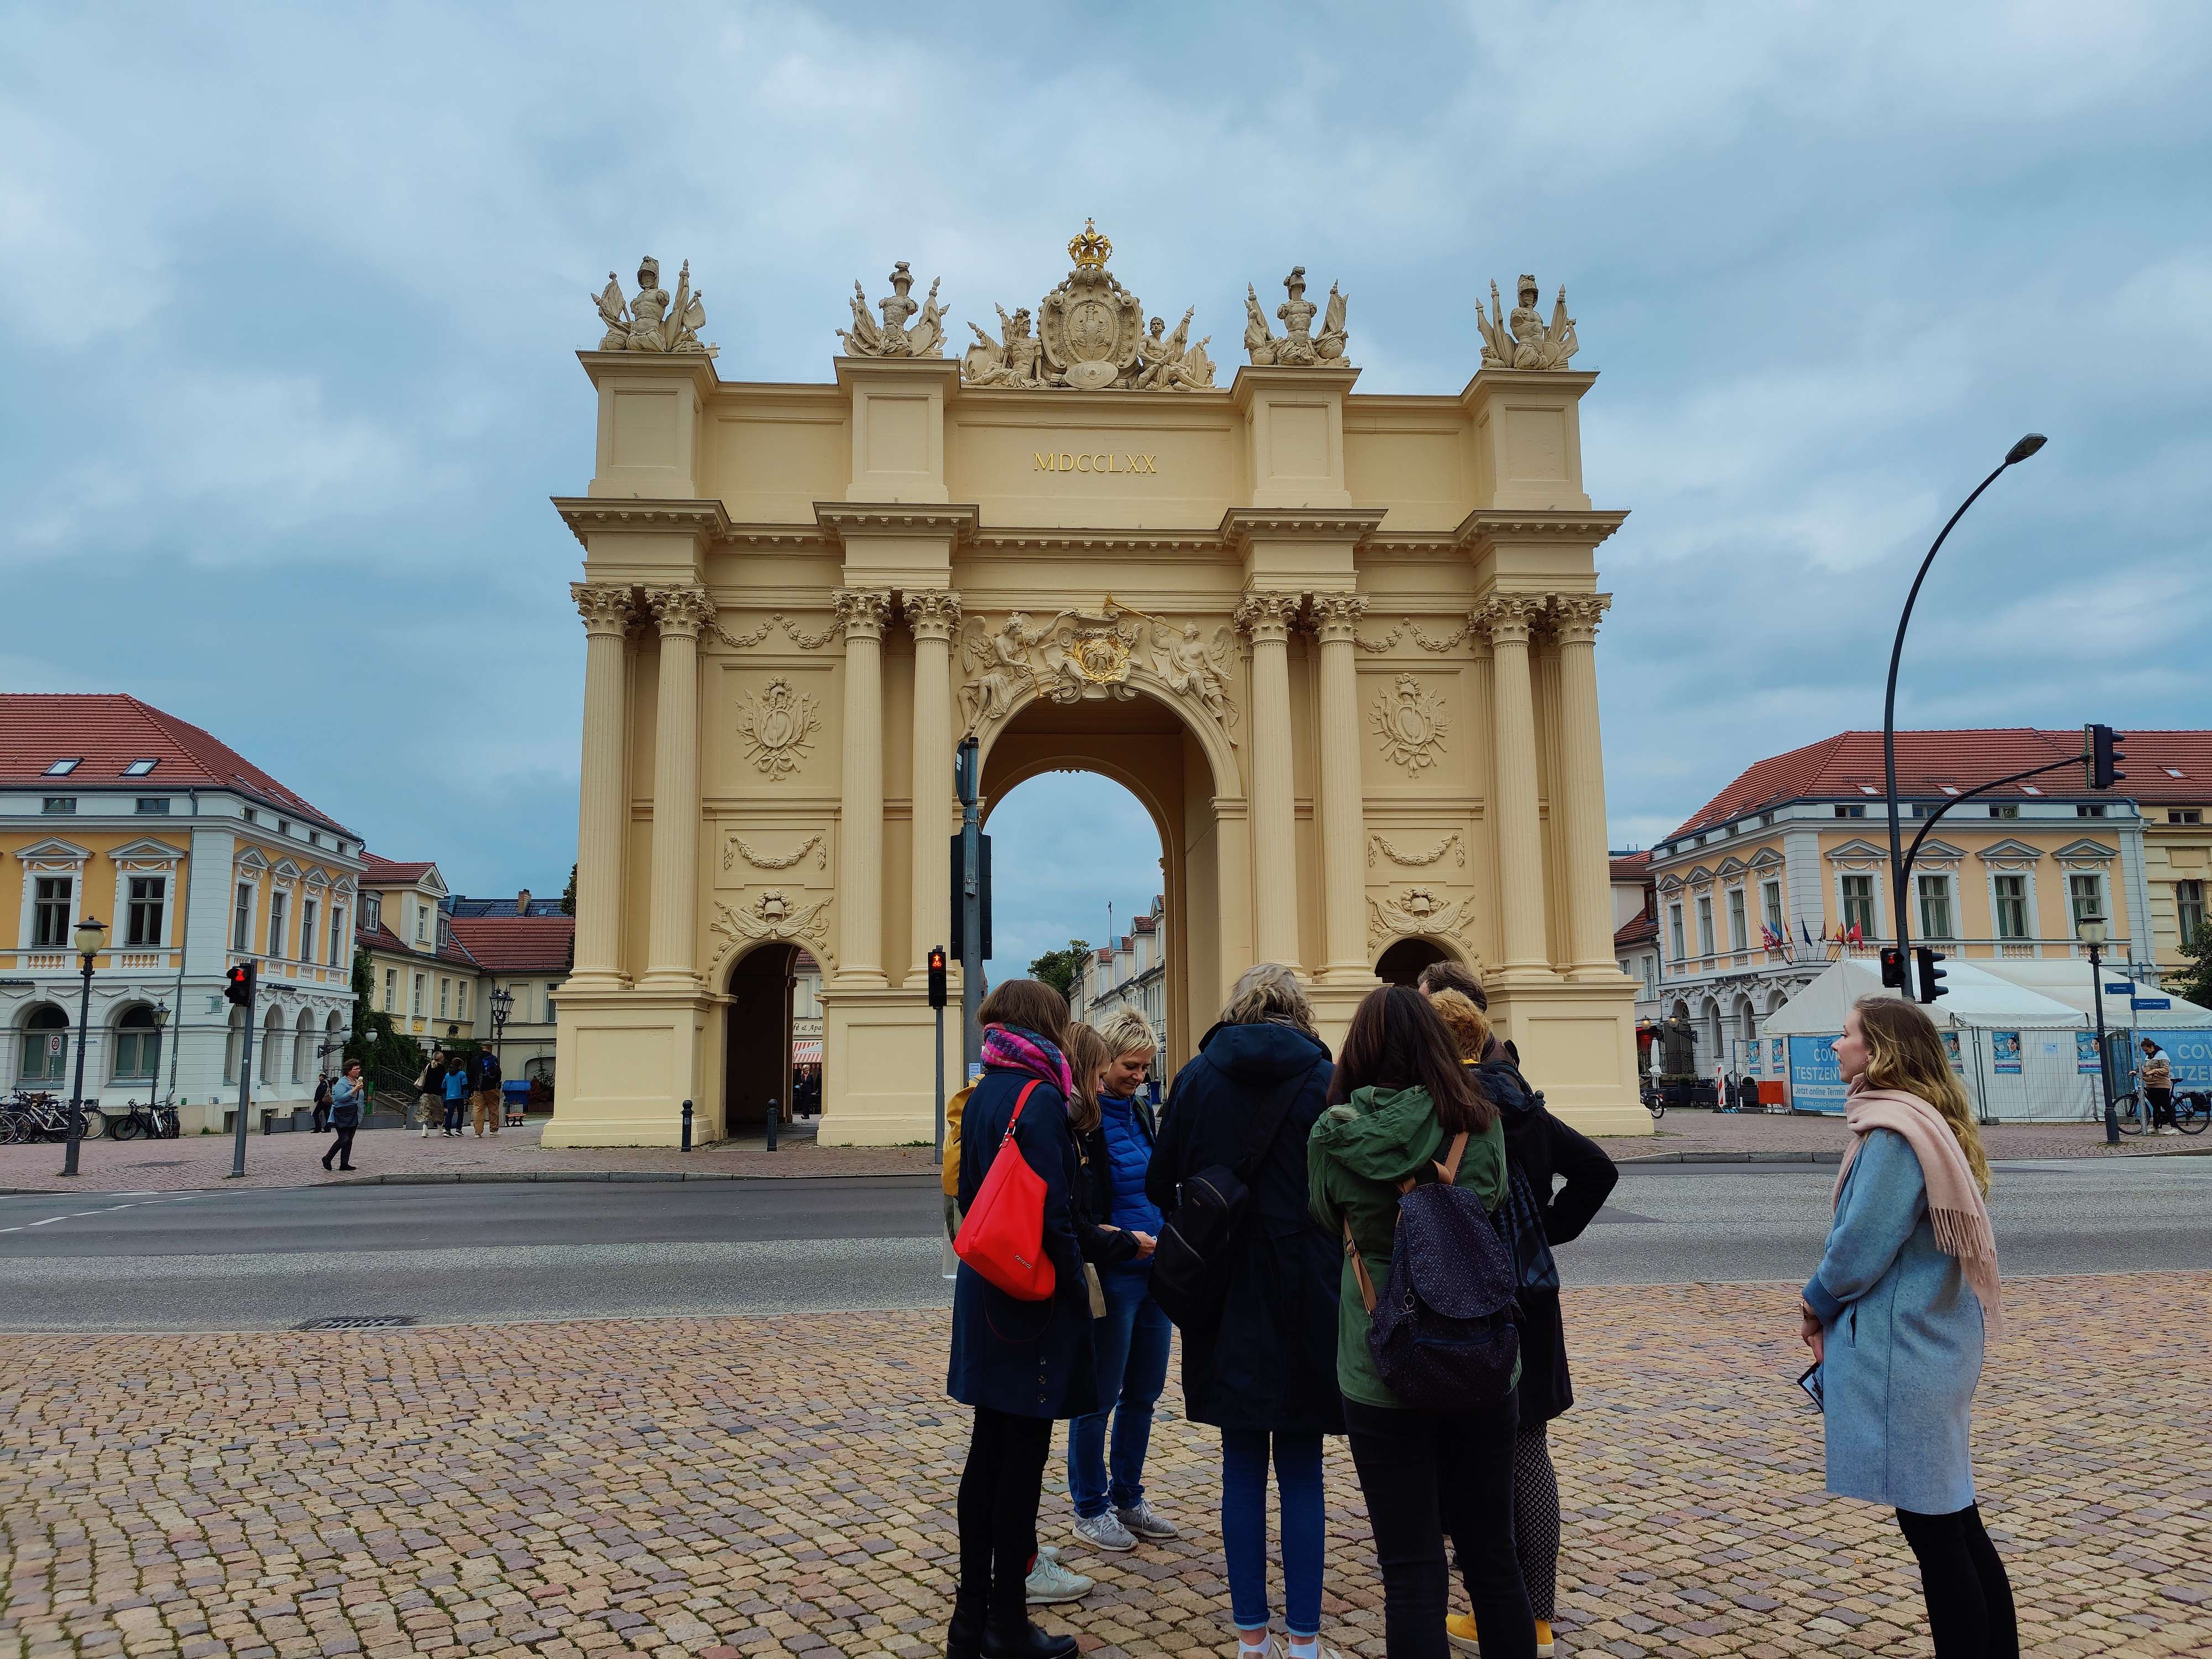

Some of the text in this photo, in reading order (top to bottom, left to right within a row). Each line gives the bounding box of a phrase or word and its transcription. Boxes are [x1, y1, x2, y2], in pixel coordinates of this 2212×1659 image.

[1034, 453, 1157, 473] MDCCLXX
[1795, 1087, 1845, 1095] Jetzt online Termin
